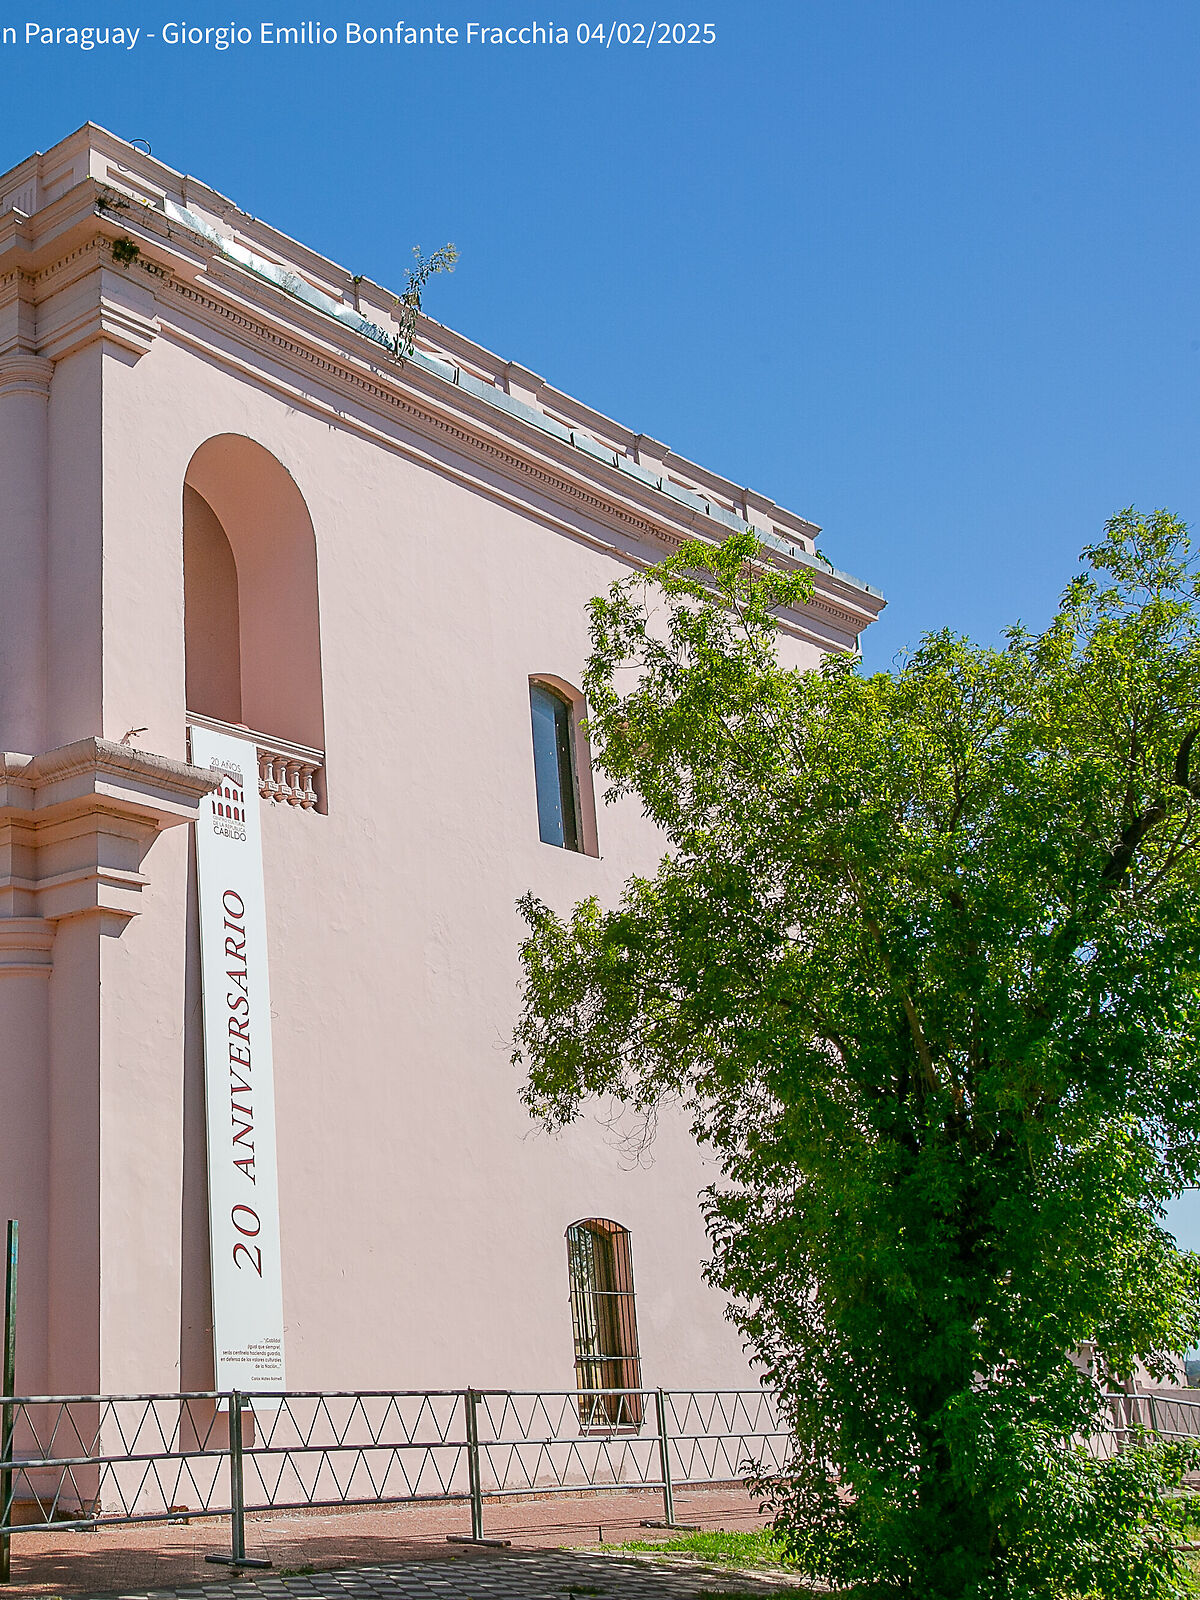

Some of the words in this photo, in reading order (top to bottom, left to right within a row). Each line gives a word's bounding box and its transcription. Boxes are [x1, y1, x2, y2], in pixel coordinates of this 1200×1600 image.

[211, 757, 219, 766] 20
[221, 760, 241, 772] AÑOS
[213, 826, 246, 841] CABILDO
[221, 888, 256, 1186] ANIVERSARIO
[230, 1203, 263, 1278] 20
